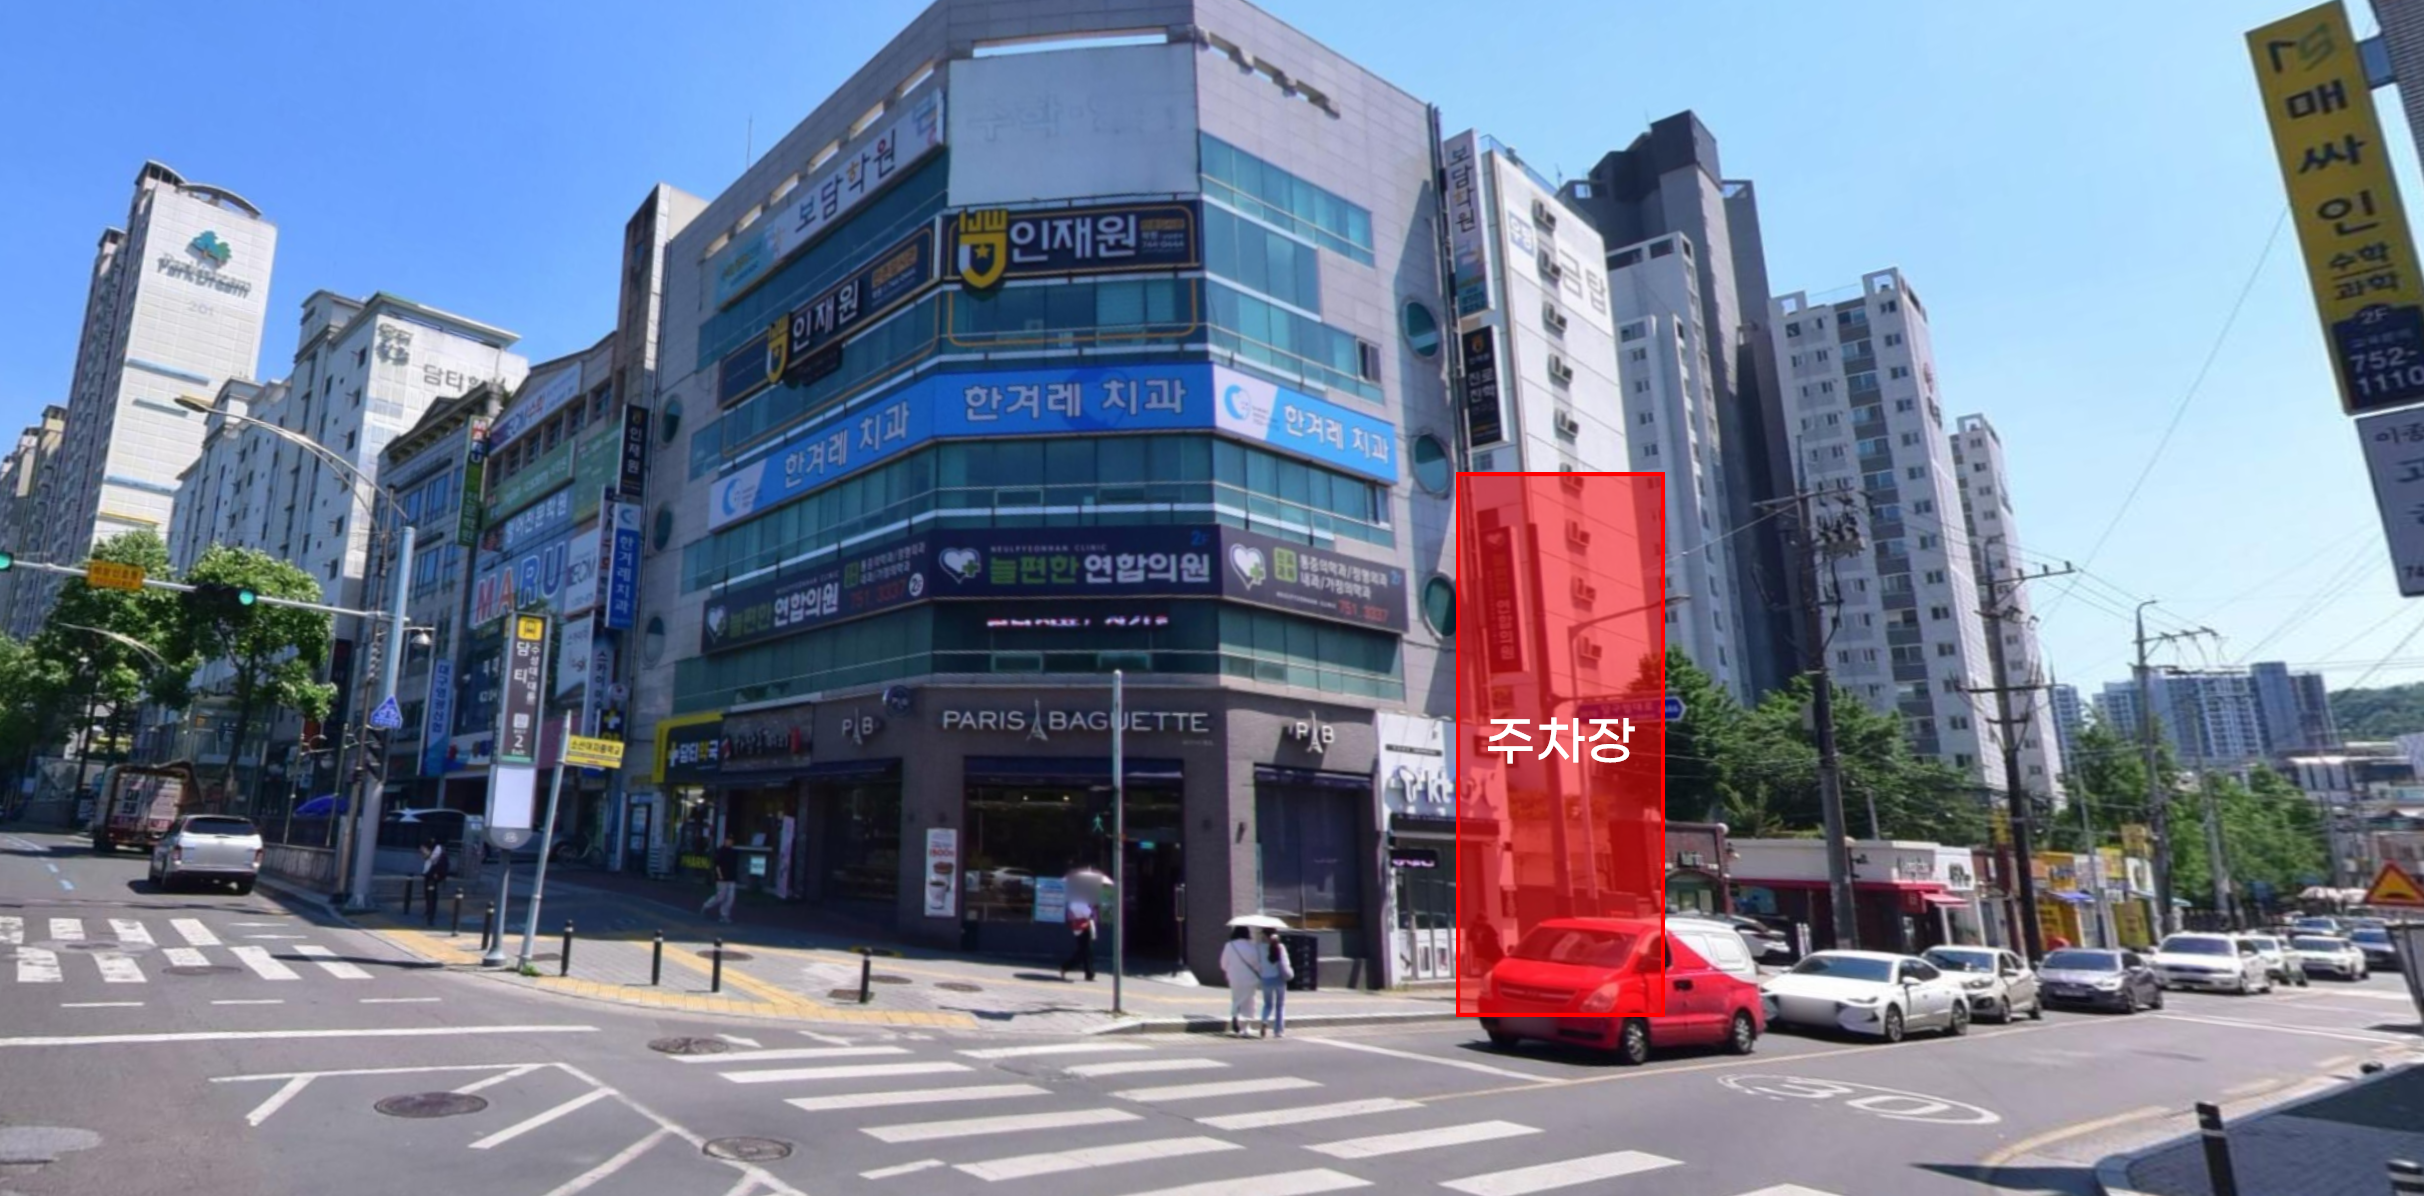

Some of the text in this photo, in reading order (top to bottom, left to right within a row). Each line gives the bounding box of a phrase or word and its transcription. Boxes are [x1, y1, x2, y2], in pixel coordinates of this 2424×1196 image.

[794, 128, 897, 234] 보담학원
[2285, 78, 2379, 237] 매싸인
[1450, 144, 1476, 234] 보담학원
[1010, 214, 1136, 263] 인재원
[2329, 242, 2391, 270] 수학
[1559, 248, 1606, 316] 금탑
[2334, 271, 2400, 300] 과학
[793, 279, 859, 353] 인재원
[964, 378, 1187, 422] 한겨레 치과
[627, 427, 643, 475] 인재원
[785, 401, 910, 489] 한겨레 치과
[1284, 404, 1344, 450] 한겨레
[1352, 427, 1389, 464] 치과
[1074, 543, 1107, 552] CLINIC
[1190, 531, 1210, 547] 2F
[474, 541, 565, 626] MARU
[990, 553, 1210, 584] 늘편한 연합의원
[729, 582, 839, 638] 늘편한 연합의원
[513, 641, 529, 685] 담티
[514, 734, 524, 748] 2
[942, 710, 1209, 733] PARIS BAGUETTE
[680, 740, 719, 763] 담티약국
